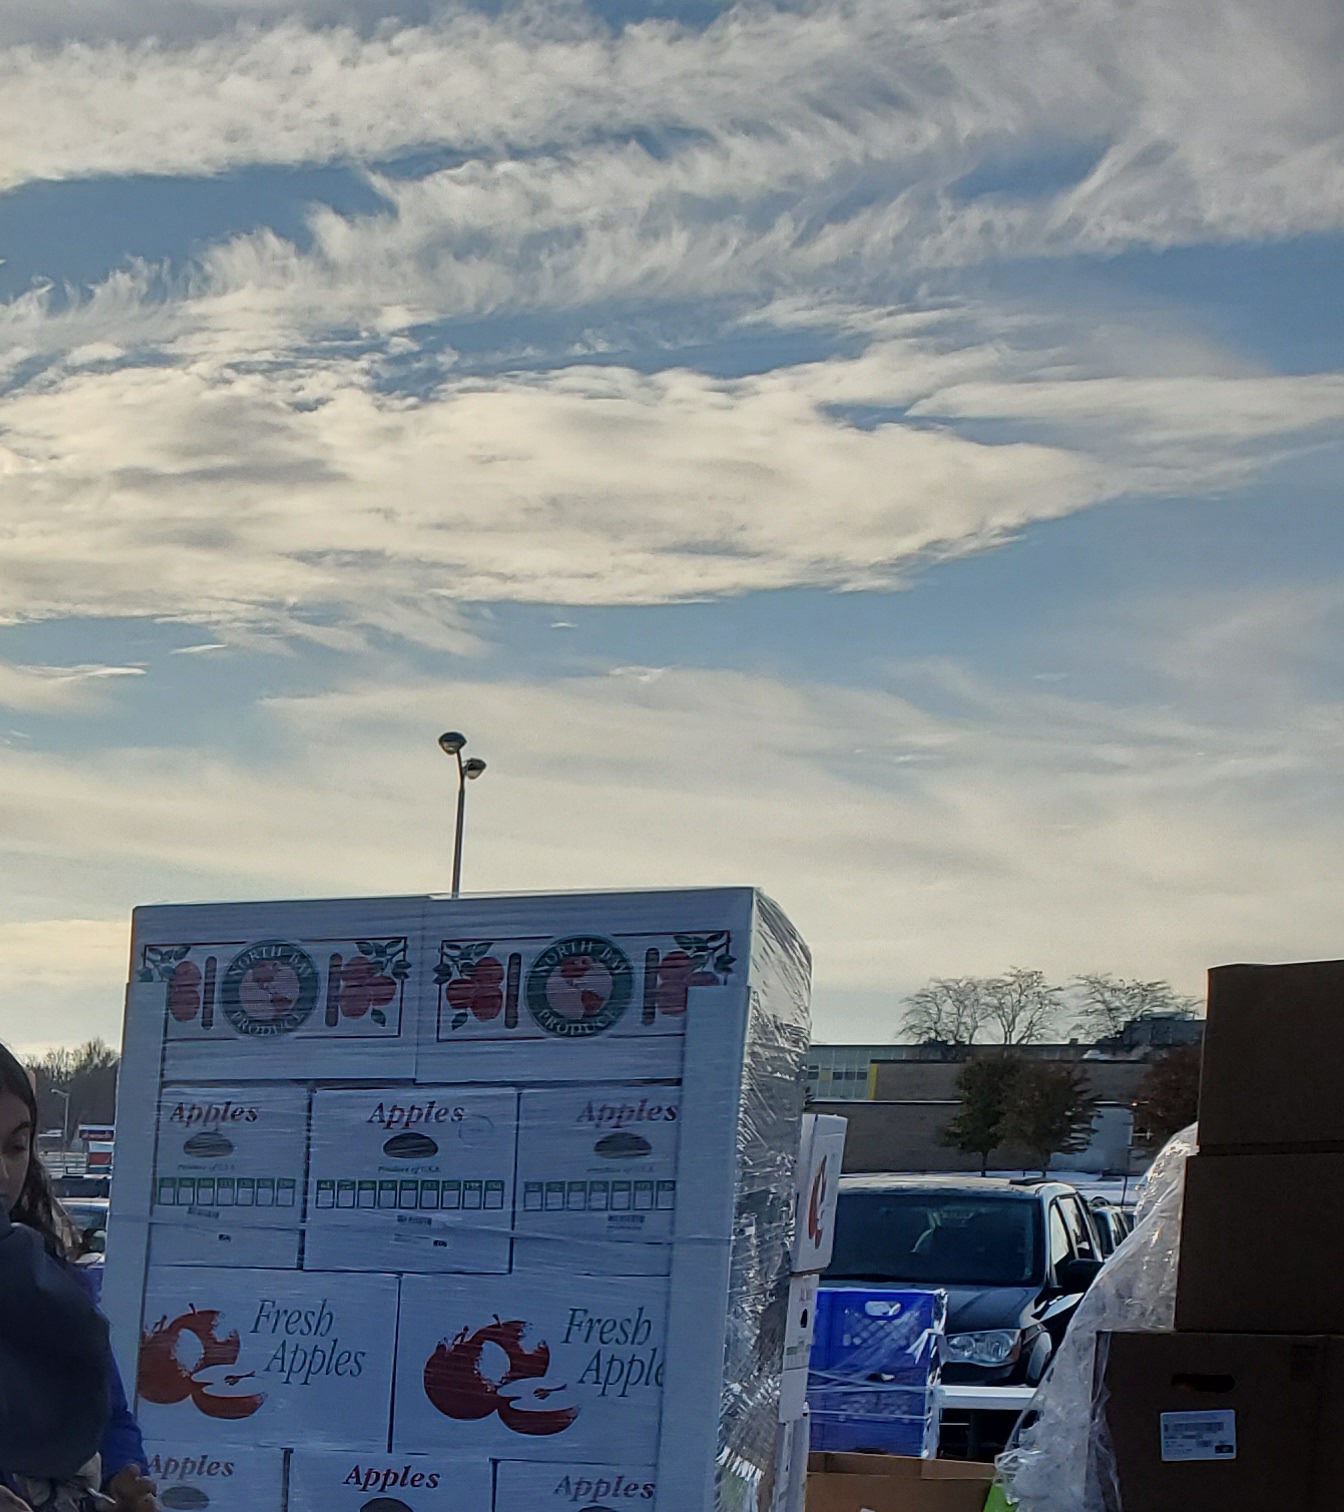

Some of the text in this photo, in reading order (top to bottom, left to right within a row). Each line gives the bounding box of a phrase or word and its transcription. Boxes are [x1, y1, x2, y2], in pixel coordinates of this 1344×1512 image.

[170, 1101, 258, 1130] Apples
[366, 1100, 465, 1130] Apples
[576, 1098, 679, 1128] Apples
[250, 1298, 333, 1338] Fresh
[560, 1305, 651, 1346] Fresh
[264, 1338, 366, 1386] Apples
[577, 1347, 664, 1397] Apple
[149, 1454, 235, 1479] Apples
[342, 1464, 441, 1492] Apples
[553, 1474, 656, 1503] Apples
